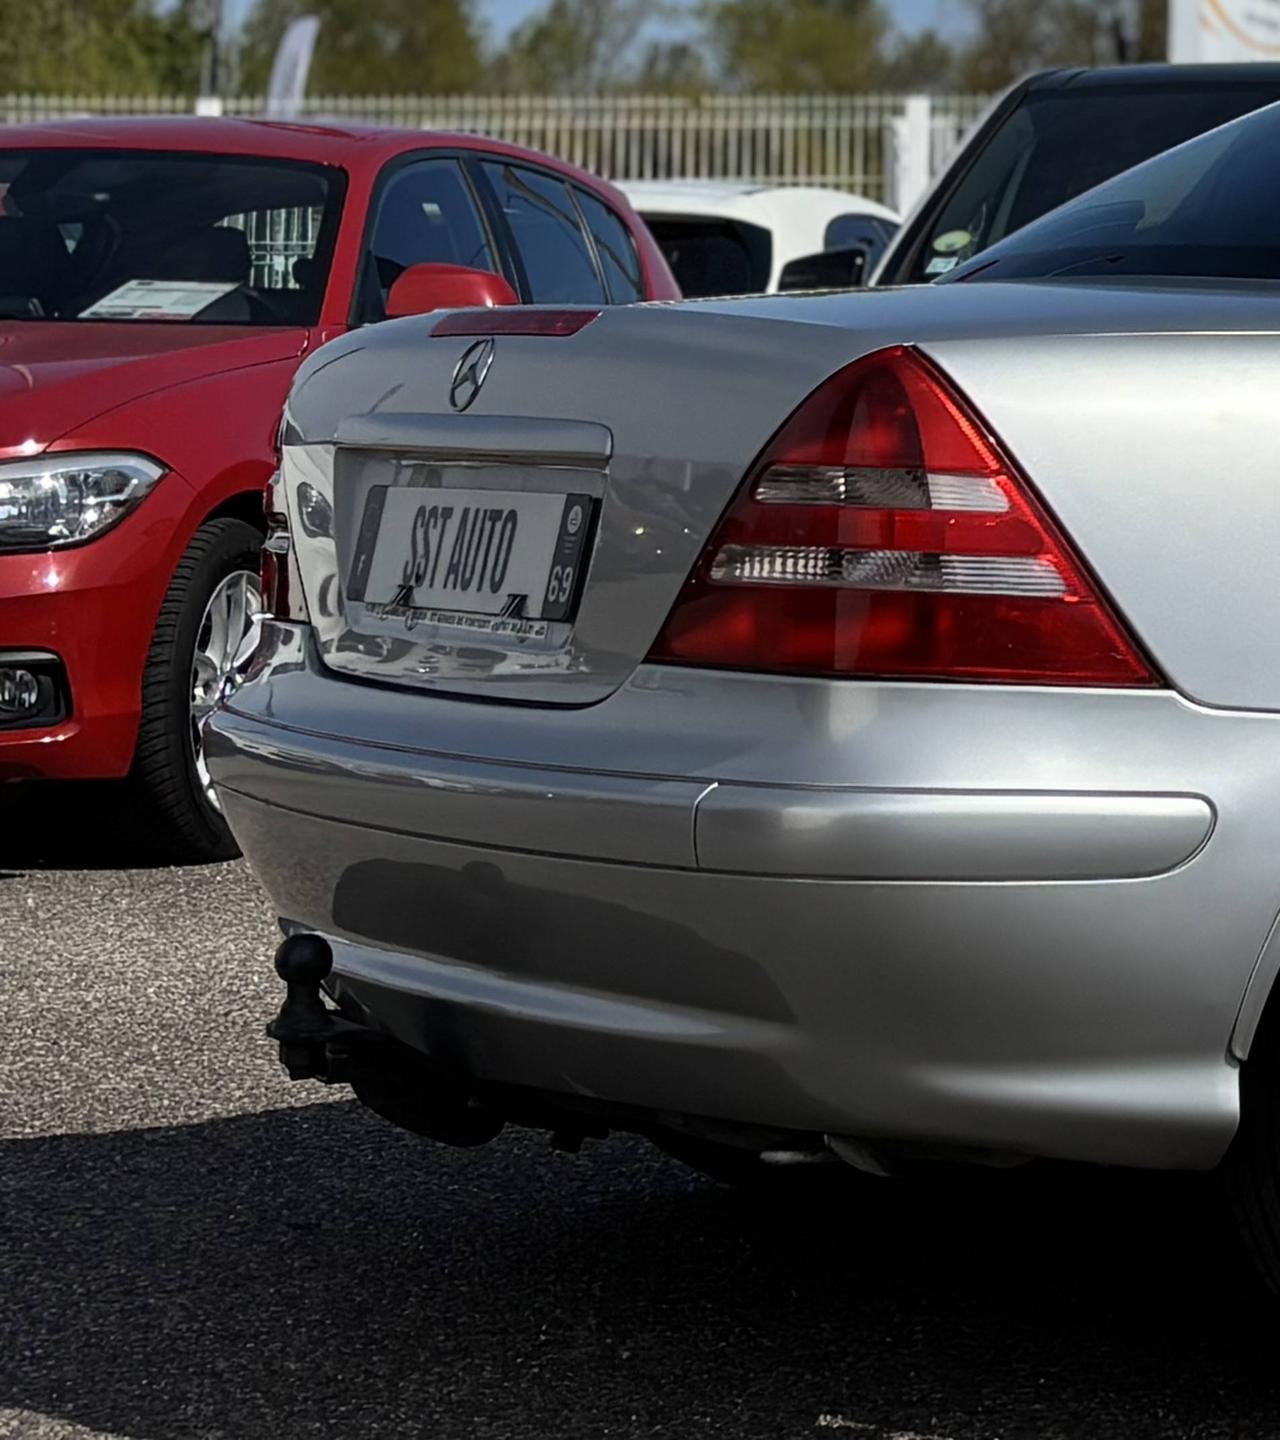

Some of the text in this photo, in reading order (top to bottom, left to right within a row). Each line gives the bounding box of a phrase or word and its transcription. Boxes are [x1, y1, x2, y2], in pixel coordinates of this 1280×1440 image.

[402, 504, 518, 594] SST AUTO
[548, 564, 574, 603] 69
